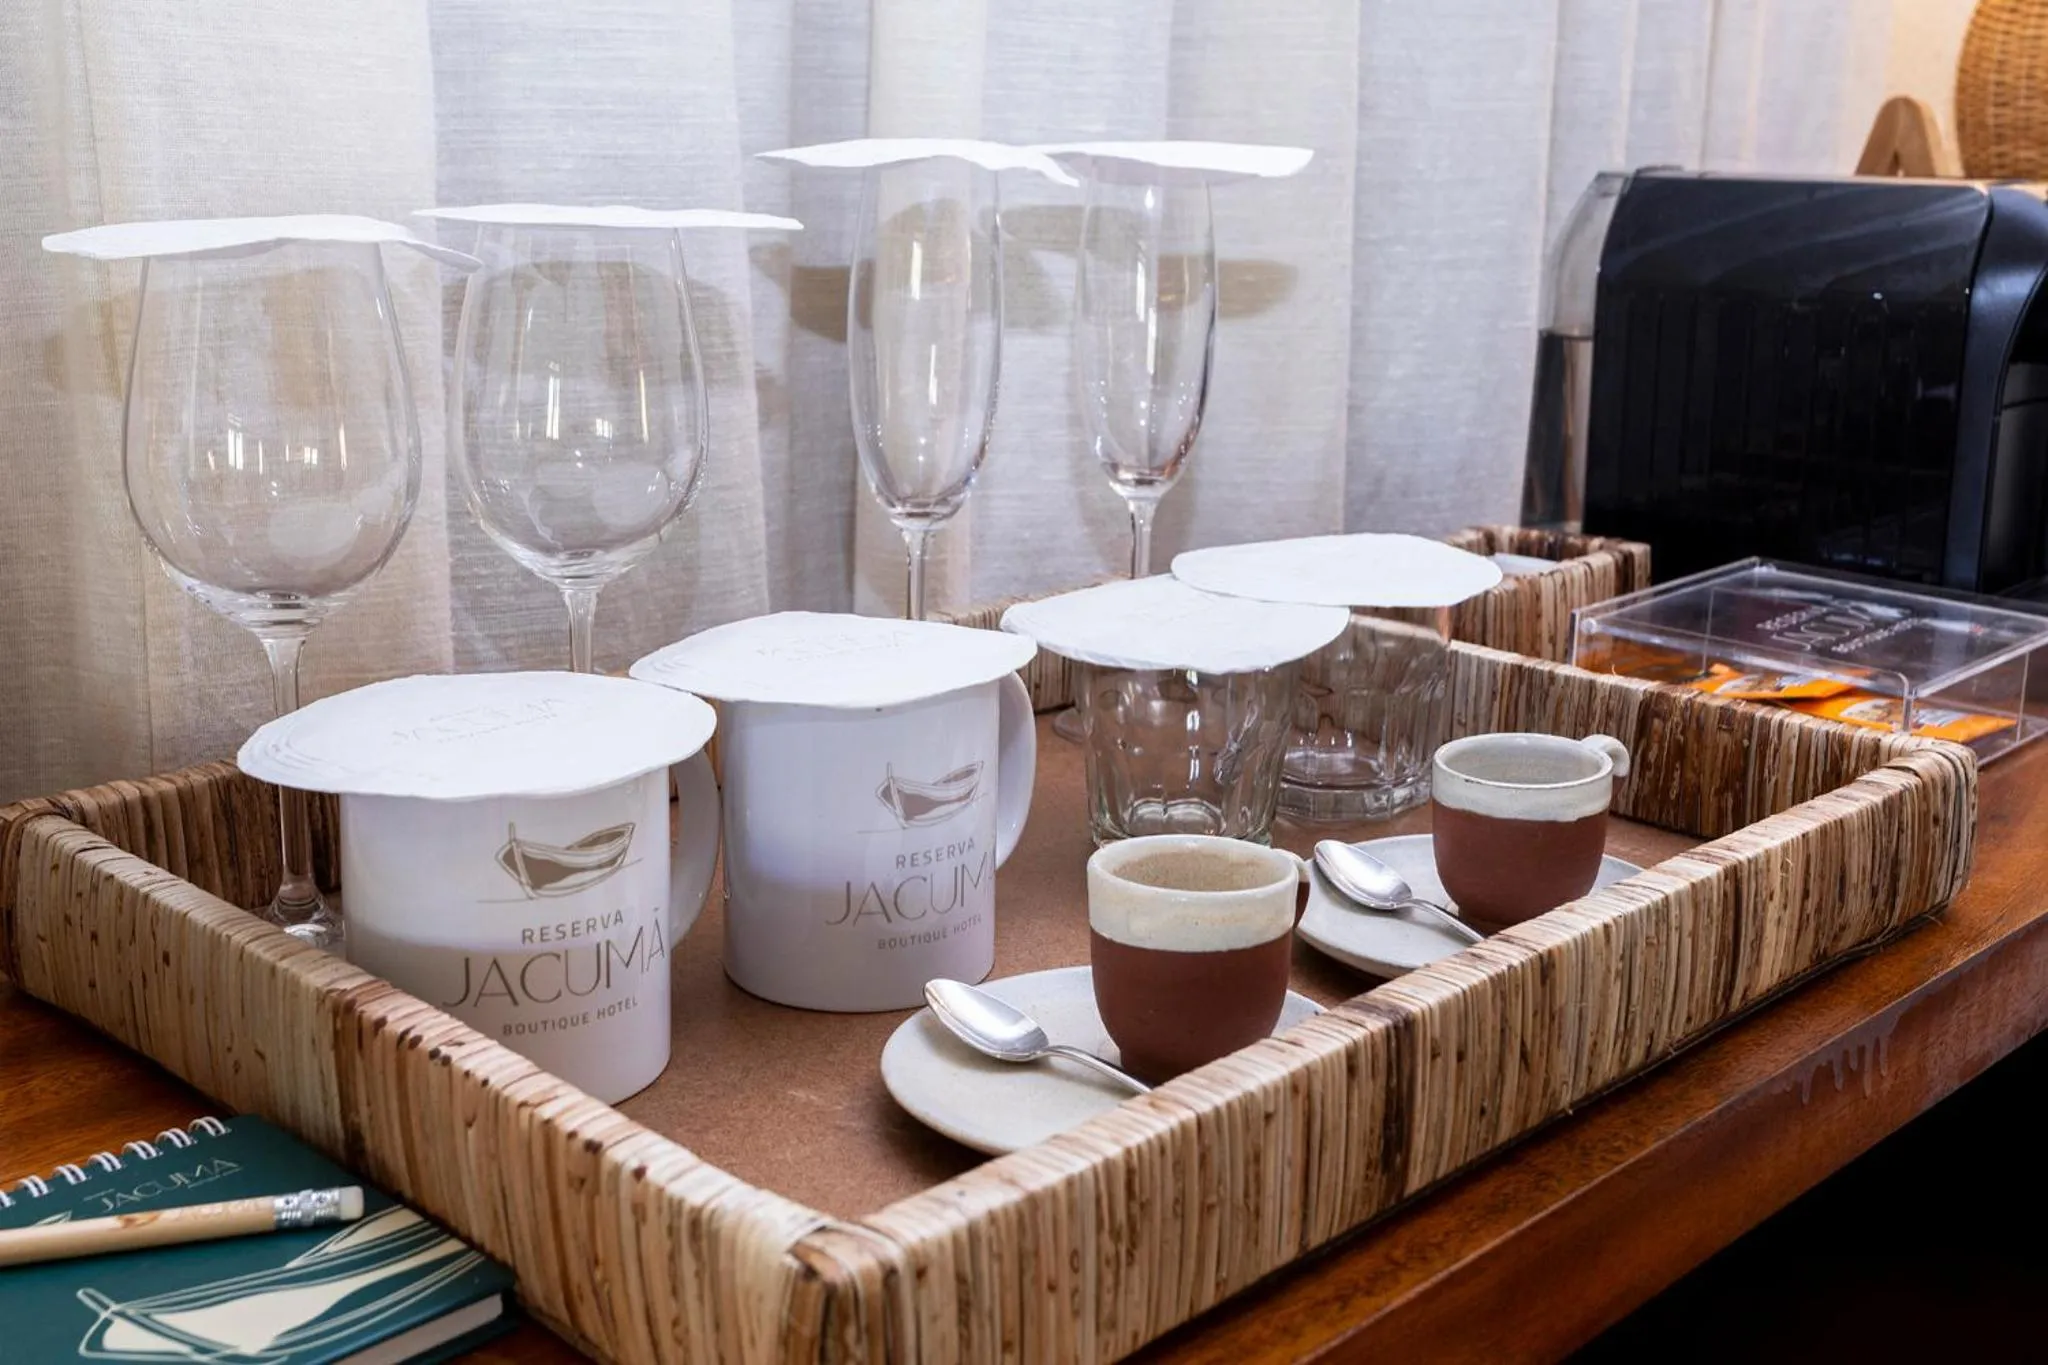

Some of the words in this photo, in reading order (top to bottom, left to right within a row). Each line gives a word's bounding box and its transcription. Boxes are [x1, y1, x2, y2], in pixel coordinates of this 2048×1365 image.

[895, 836, 975, 870] RESERVA
[824, 851, 992, 927] JACUM
[520, 909, 624, 945] RESERVA
[877, 927, 949, 950] BOUTIQUE
[953, 913, 982, 936] HOTEL
[442, 906, 666, 1008] JACUMÁ
[502, 1011, 590, 1037] BOUTIQUE
[596, 996, 638, 1020] HOTEL
